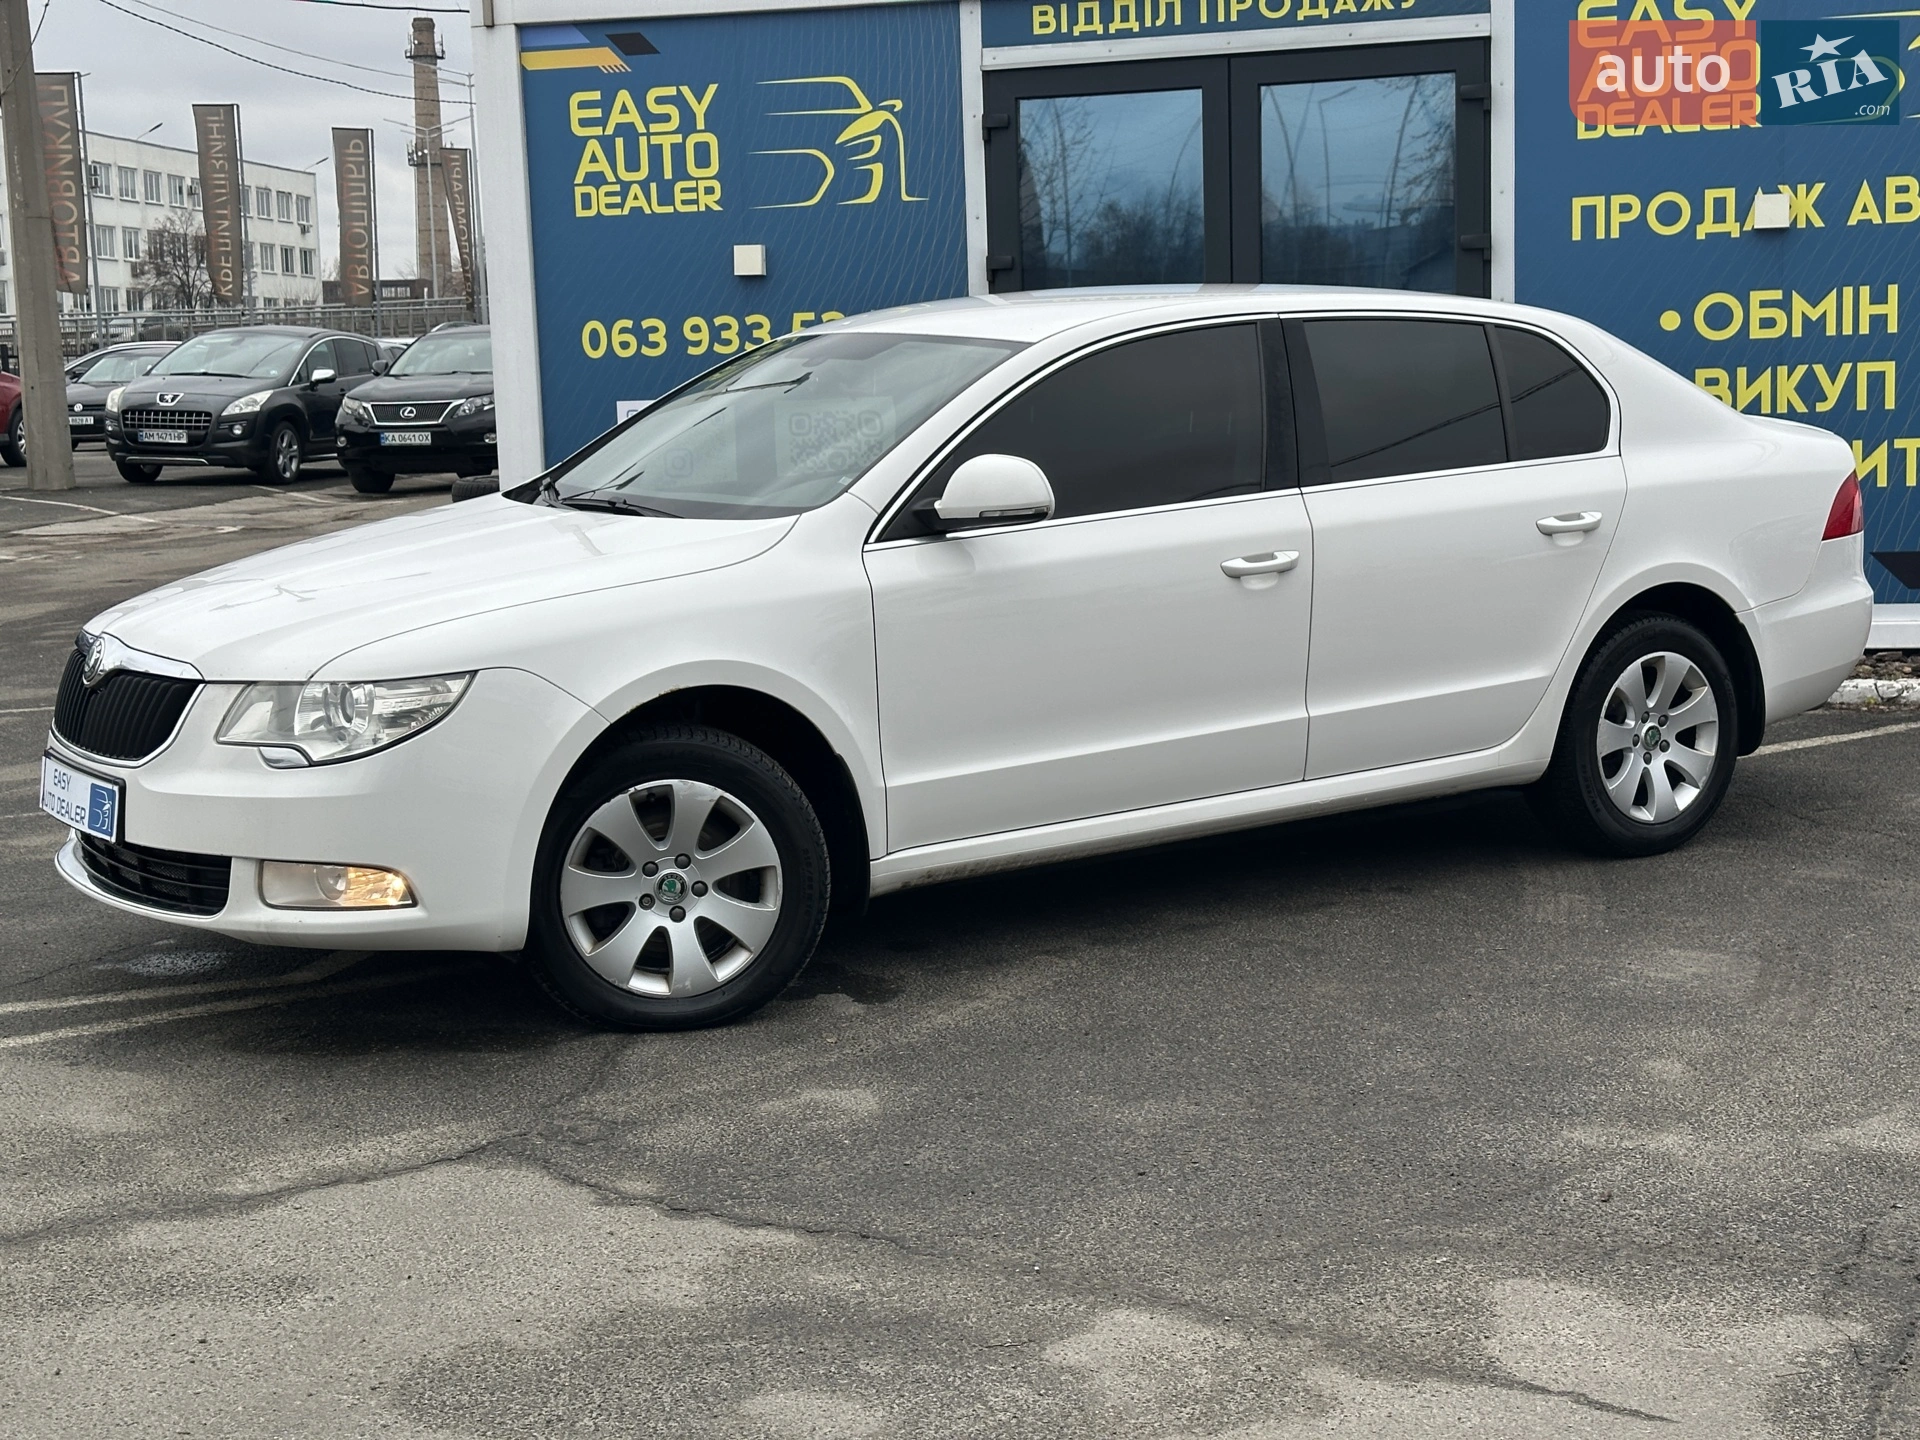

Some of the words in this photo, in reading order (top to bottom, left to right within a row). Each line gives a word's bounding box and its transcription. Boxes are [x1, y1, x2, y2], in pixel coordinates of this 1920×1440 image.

[1032, 0, 1181, 36] ВІДДІЛ
[1577, 0, 1755, 47] EASY
[1577, 39, 1762, 102] AUTO
[569, 83, 719, 137] EASY
[1577, 92, 1763, 140] DEALER
[573, 131, 720, 184] AUTO
[573, 178, 724, 218] DEALER
[1571, 181, 1826, 241] ПРОДЖ
[1693, 283, 1899, 342] ОБМІН
[581, 318, 668, 360] 063
[682, 314, 772, 356] 933
[1694, 360, 1897, 415] ВИКУП
[53, 768, 72, 792] EASY
[56, 797, 87, 825] DEALER
